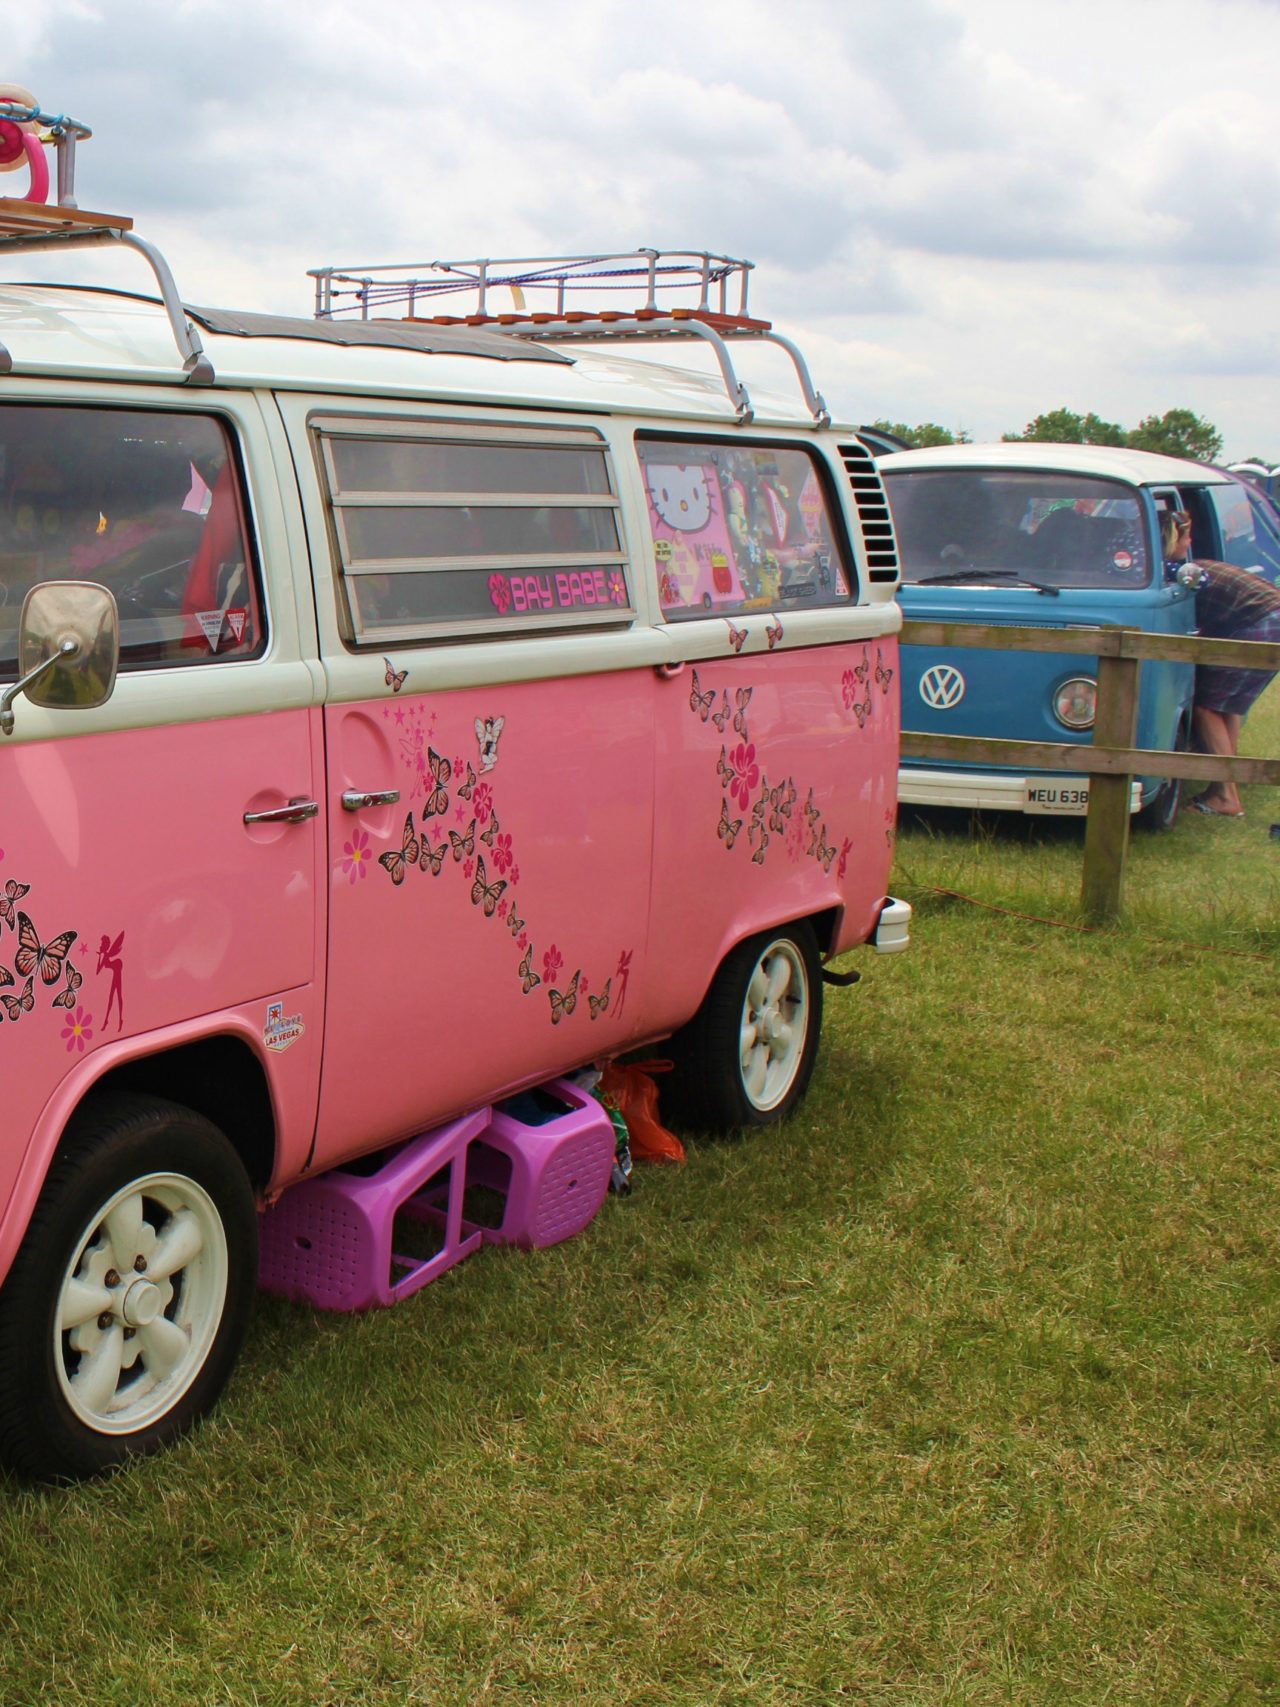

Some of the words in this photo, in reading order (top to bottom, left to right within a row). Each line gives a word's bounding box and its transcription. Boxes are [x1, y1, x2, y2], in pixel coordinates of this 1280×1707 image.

[510, 575, 554, 611] BAY
[555, 570, 609, 607] BABE
[1028, 789, 1056, 802] WEU
[1060, 790, 1089, 803] 638
[265, 1037, 277, 1046] LAS
[279, 1028, 299, 1041] VEGAS
